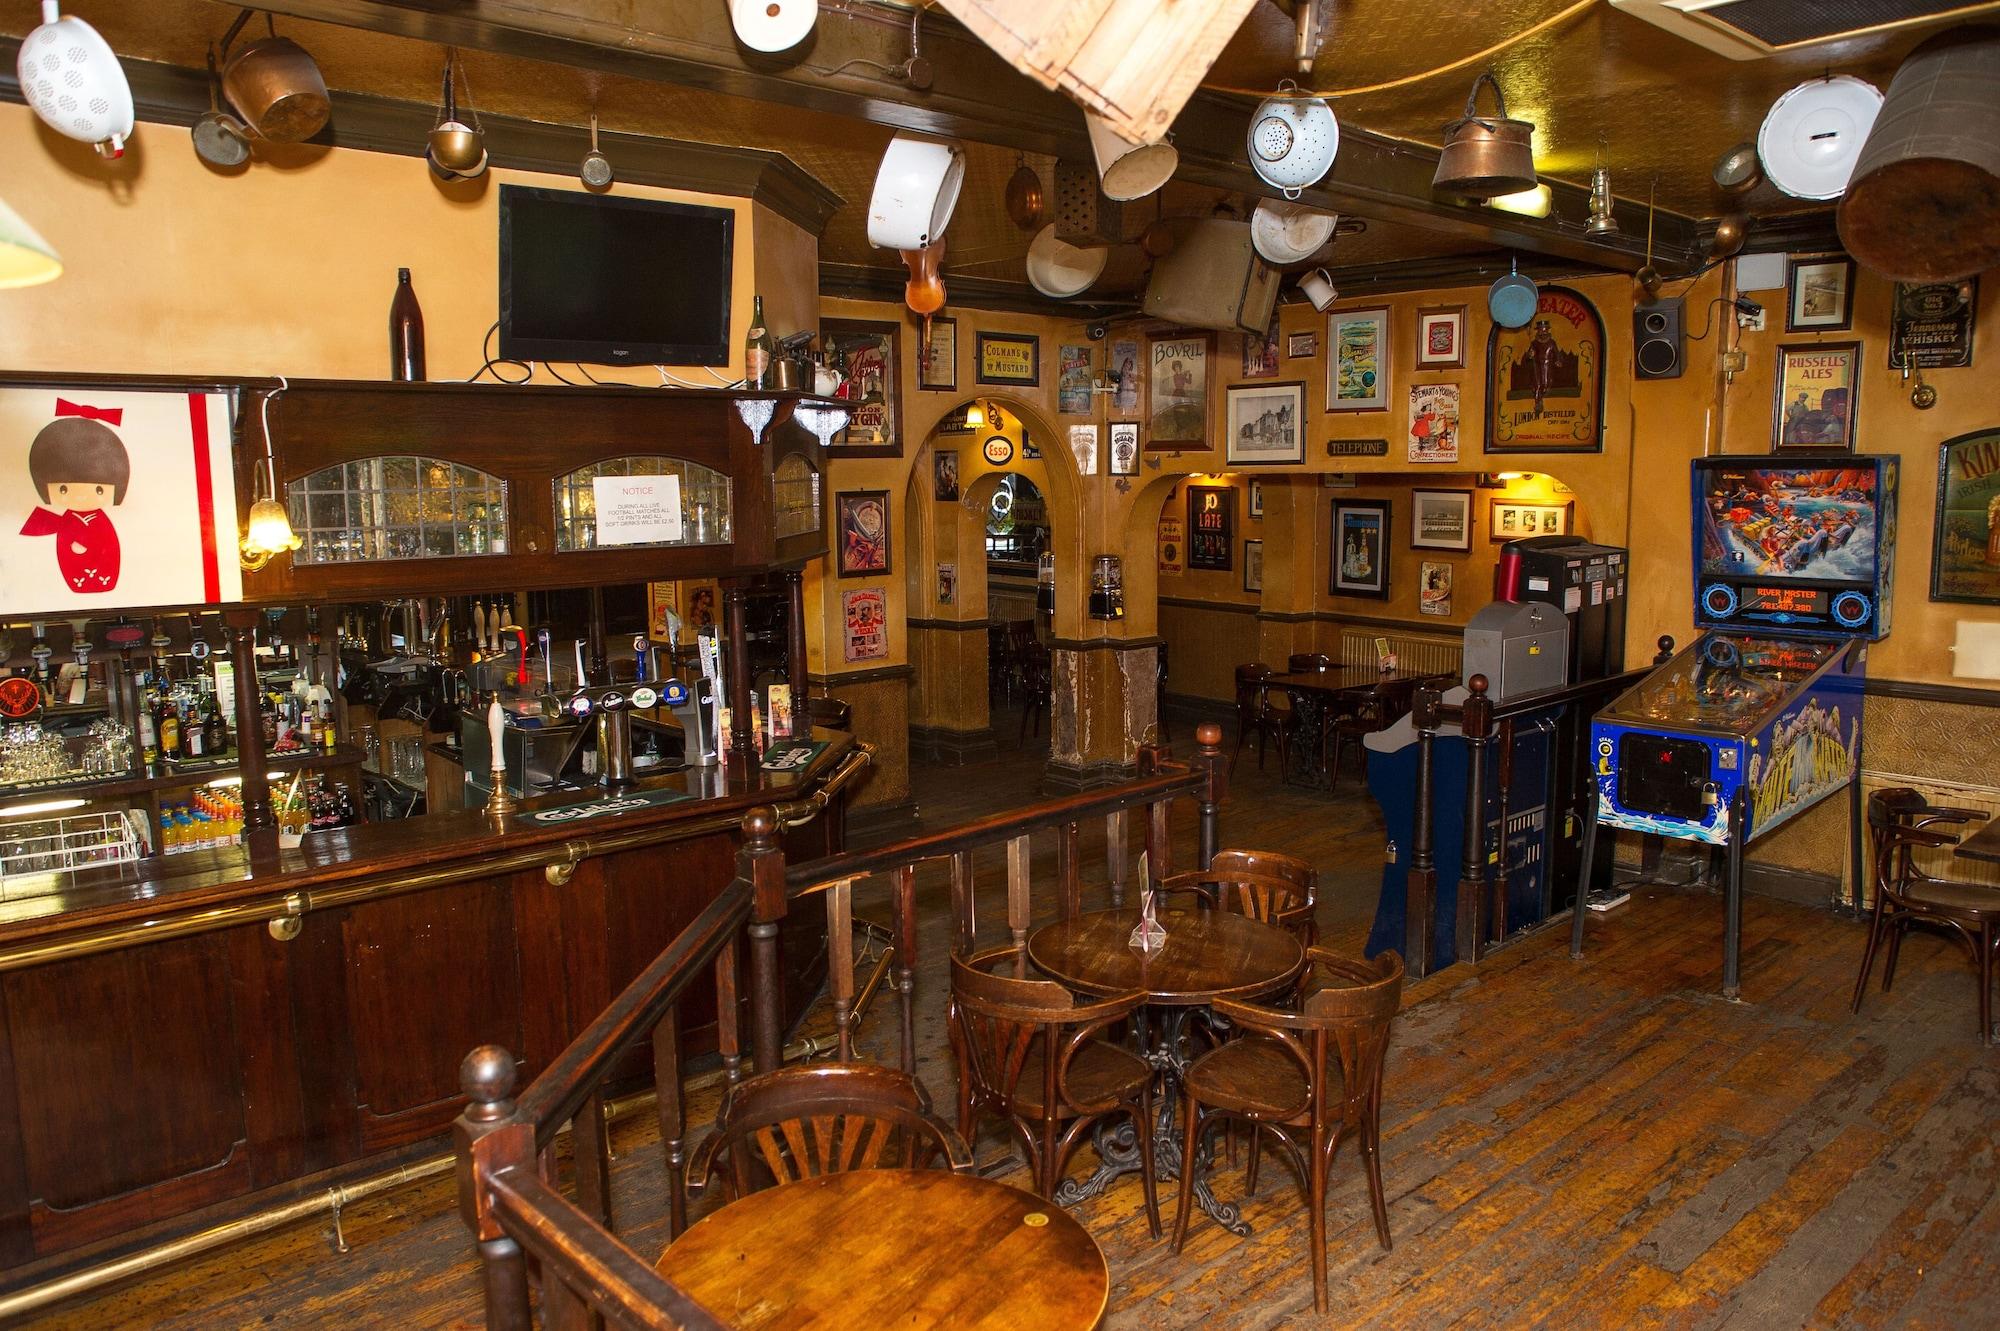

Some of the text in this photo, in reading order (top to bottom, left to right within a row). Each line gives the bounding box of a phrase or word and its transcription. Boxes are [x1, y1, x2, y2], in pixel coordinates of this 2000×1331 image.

[1541, 297, 1586, 330] EATER
[1905, 320, 1958, 332] Tennessee
[1902, 334, 1958, 344] WHISKEY
[986, 344, 1021, 358] COLMAN'S
[1155, 342, 1204, 367] BOVRIL
[995, 360, 1029, 373] MUSTARD
[1801, 368, 1833, 380] ALES
[1514, 410, 1576, 427] LONDON DISTILLED
[1331, 442, 1384, 454] TELEPHONE
[1410, 450, 1457, 460] CONFECTIONERY
[622, 487, 654, 496] NOTICE
[1199, 513, 1222, 528] LATE
[1757, 588, 1817, 598] RIVER MASTER
[534, 798, 651, 821] Carlsberg
